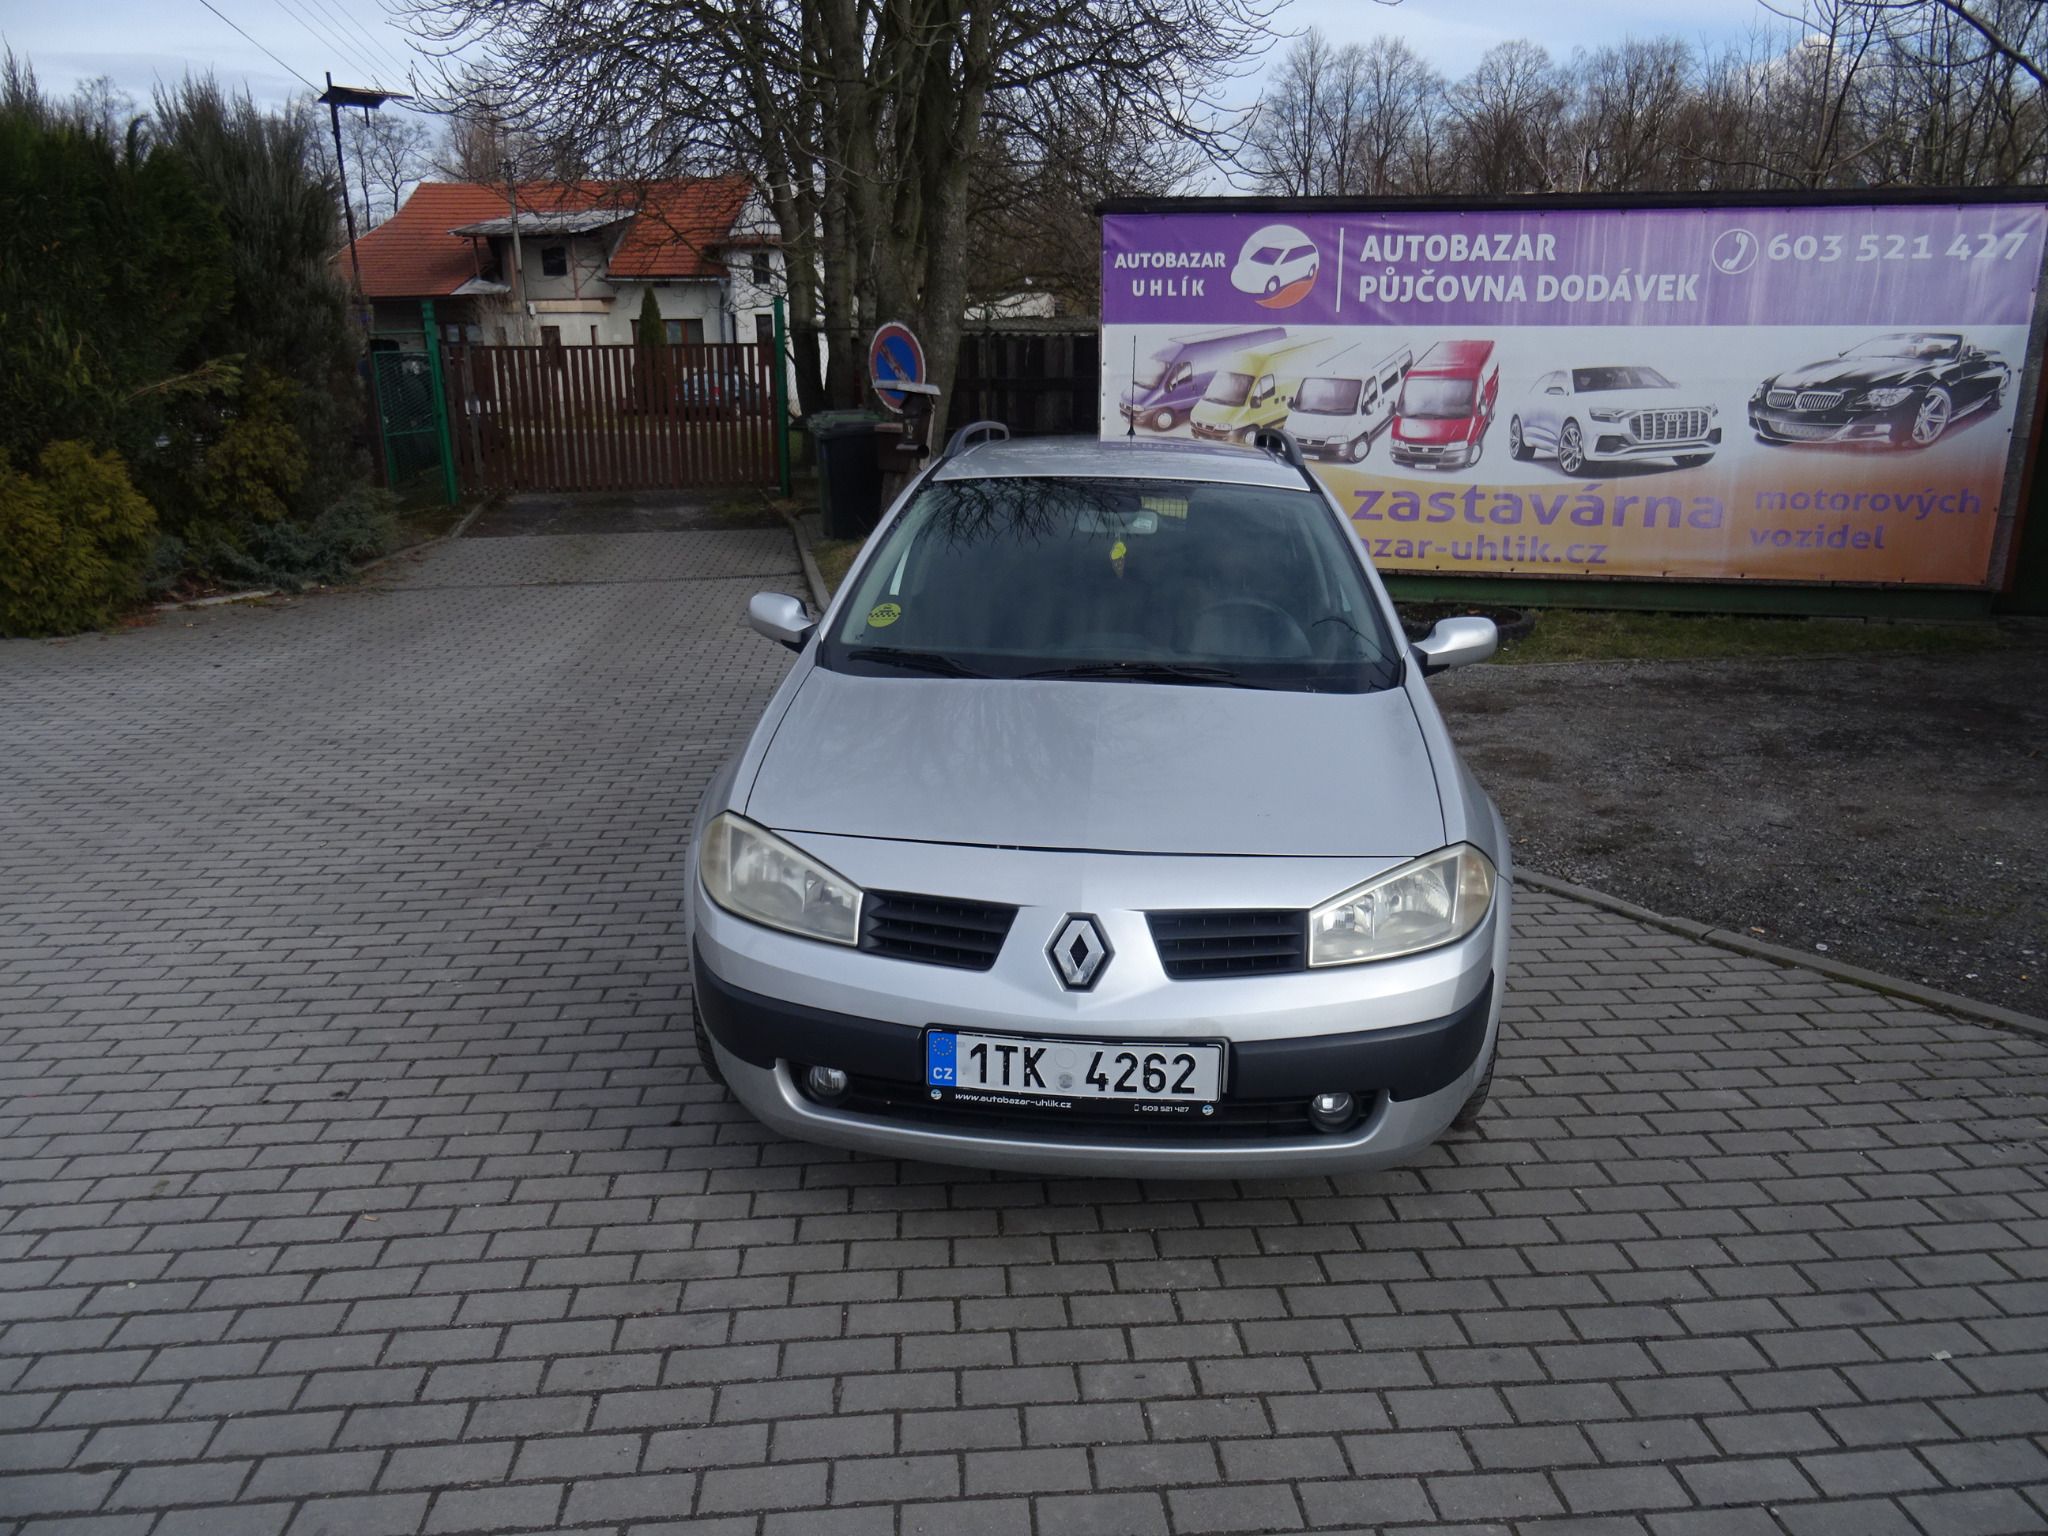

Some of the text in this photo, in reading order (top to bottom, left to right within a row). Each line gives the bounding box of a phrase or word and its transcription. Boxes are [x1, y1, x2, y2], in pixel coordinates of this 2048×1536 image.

[1114, 252, 1226, 269] AUTOBAZAR
[1360, 233, 1556, 262] AUTOBAZAR
[1767, 232, 2029, 262] 603 521 427
[1132, 276, 1205, 297] UHLÍK
[1359, 266, 1700, 303] PŮJČOVNA DODÁVEK
[1351, 483, 1724, 529] zastavárna
[1755, 488, 1981, 521] motorových
[1751, 524, 1885, 549] vozidel
[932, 1067, 952, 1080] CZ
[970, 1043, 1197, 1095] 1TK 4262
[955, 1093, 1072, 1109] www.autobazar-uhlik.cz
